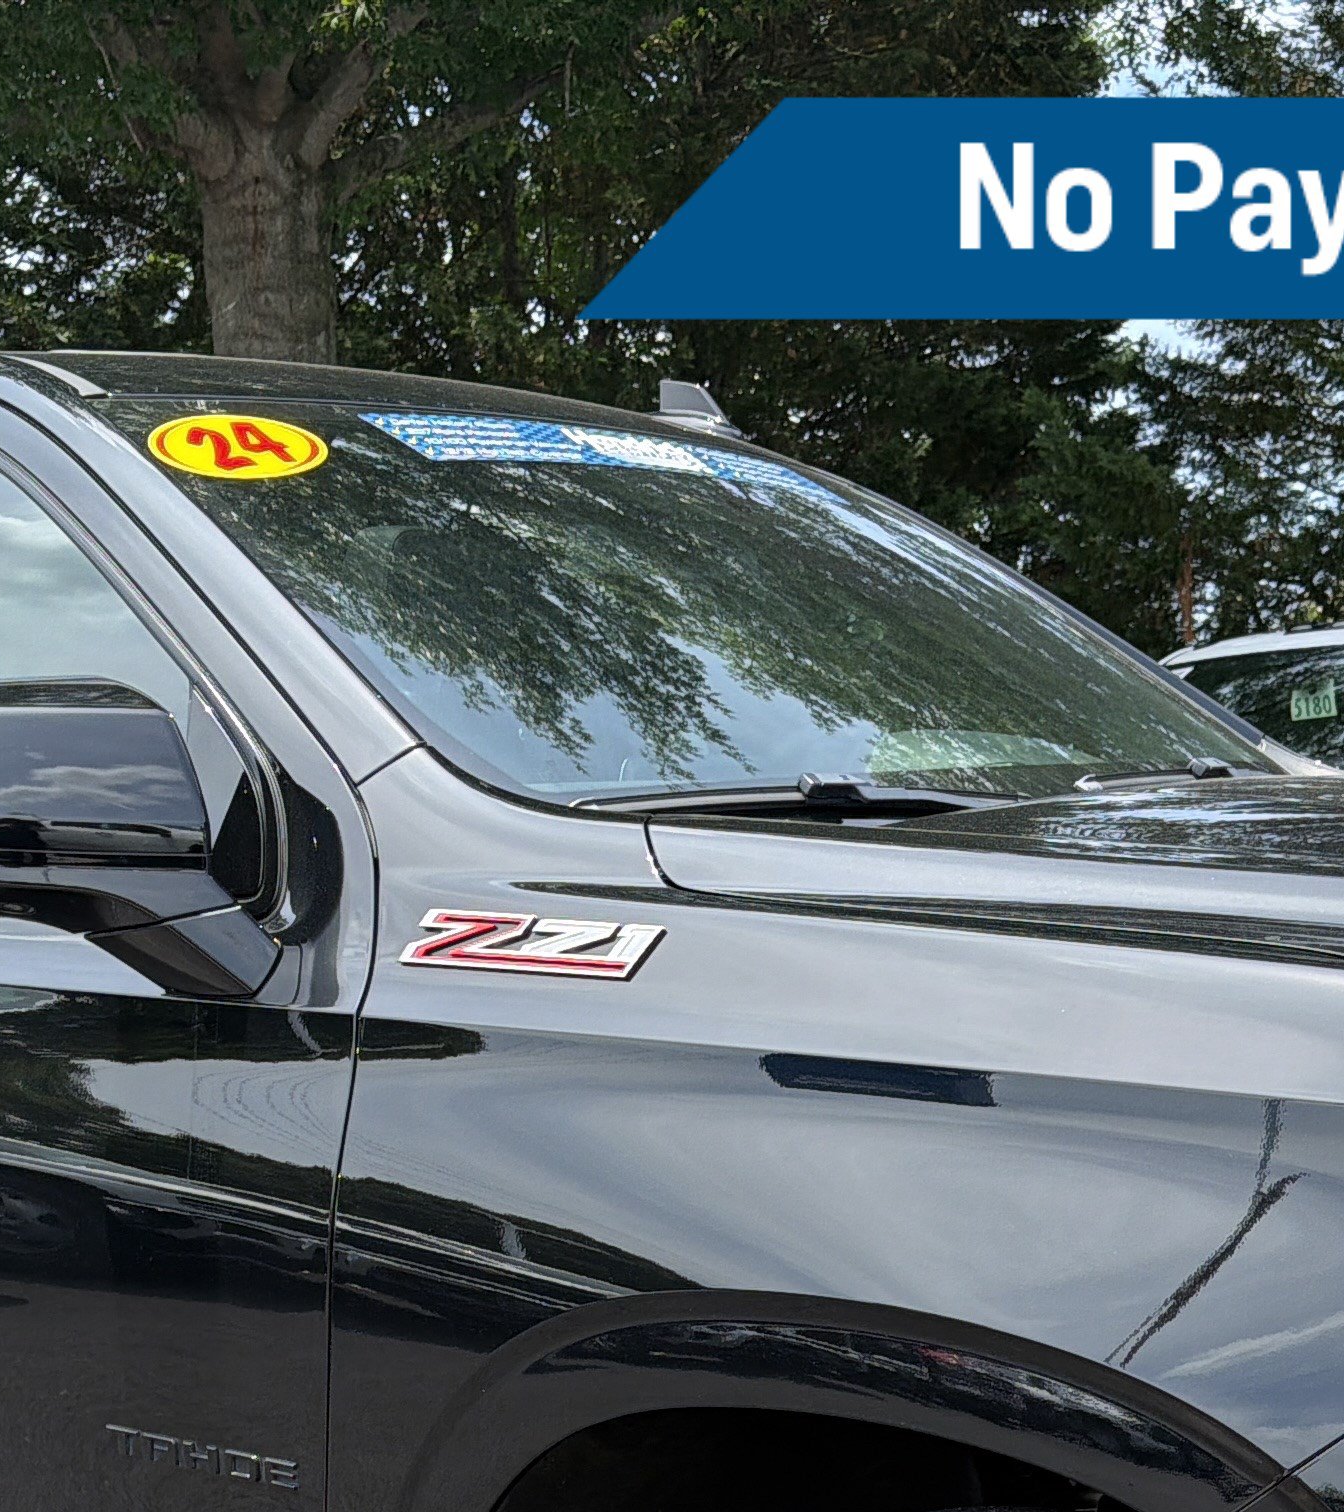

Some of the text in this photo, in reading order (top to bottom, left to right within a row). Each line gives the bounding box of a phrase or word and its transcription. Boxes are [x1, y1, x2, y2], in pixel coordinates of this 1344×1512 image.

[186, 421, 298, 472] 24
[1294, 694, 1333, 718] 5180
[398, 907, 667, 980] Z71
[106, 1422, 299, 1490] TAHOE
